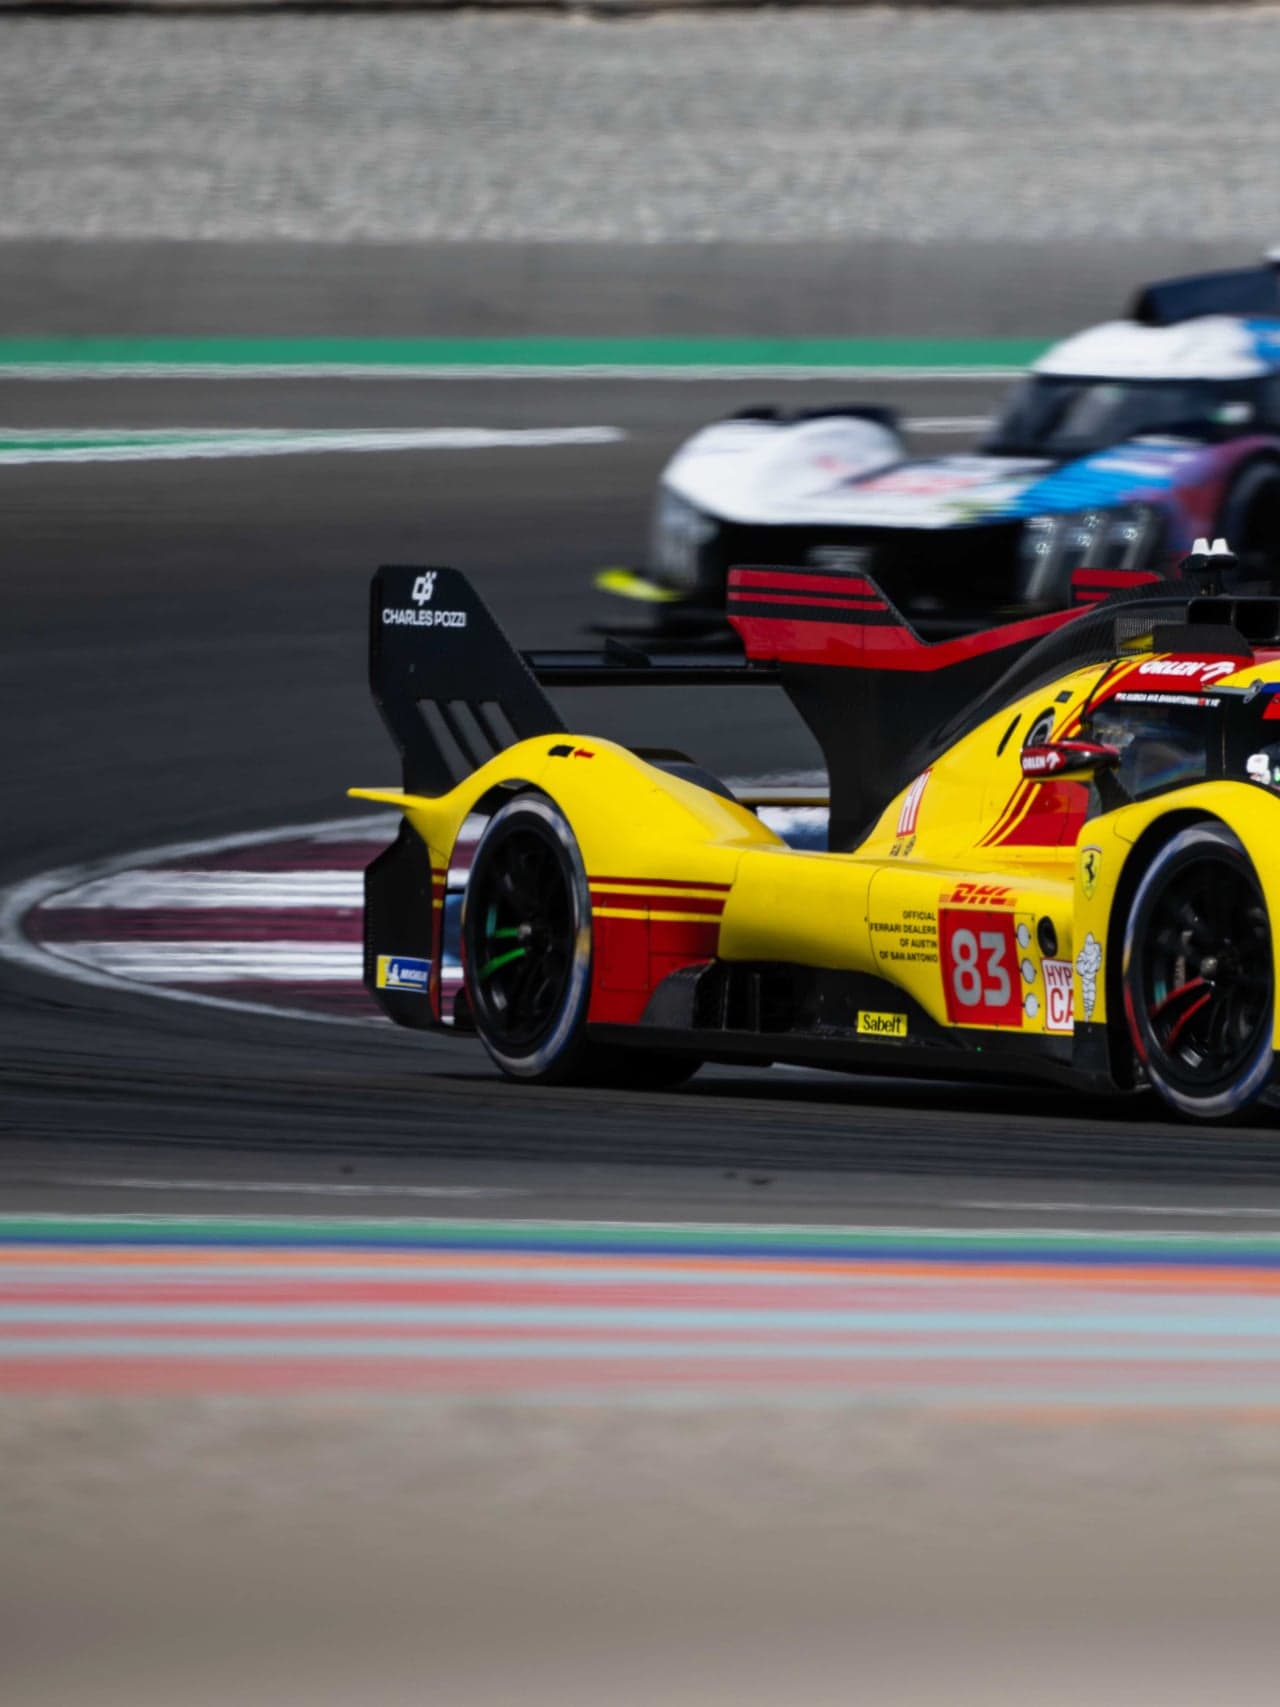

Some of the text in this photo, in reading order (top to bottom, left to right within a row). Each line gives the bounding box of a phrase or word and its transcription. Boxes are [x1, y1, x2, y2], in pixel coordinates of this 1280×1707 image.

[382, 608, 466, 627] CHARLES POZZI
[1139, 661, 1206, 676] ORLEN
[949, 883, 1011, 905] DHL
[902, 910, 937, 921] OFFICIAL
[870, 922, 937, 935] FERRARI DEALERS
[899, 938, 938, 949] OF AUSTIN
[879, 950, 938, 963] OF SAN ANTONIO
[951, 928, 1011, 1006] 83
[863, 1013, 902, 1034] Sabelt
